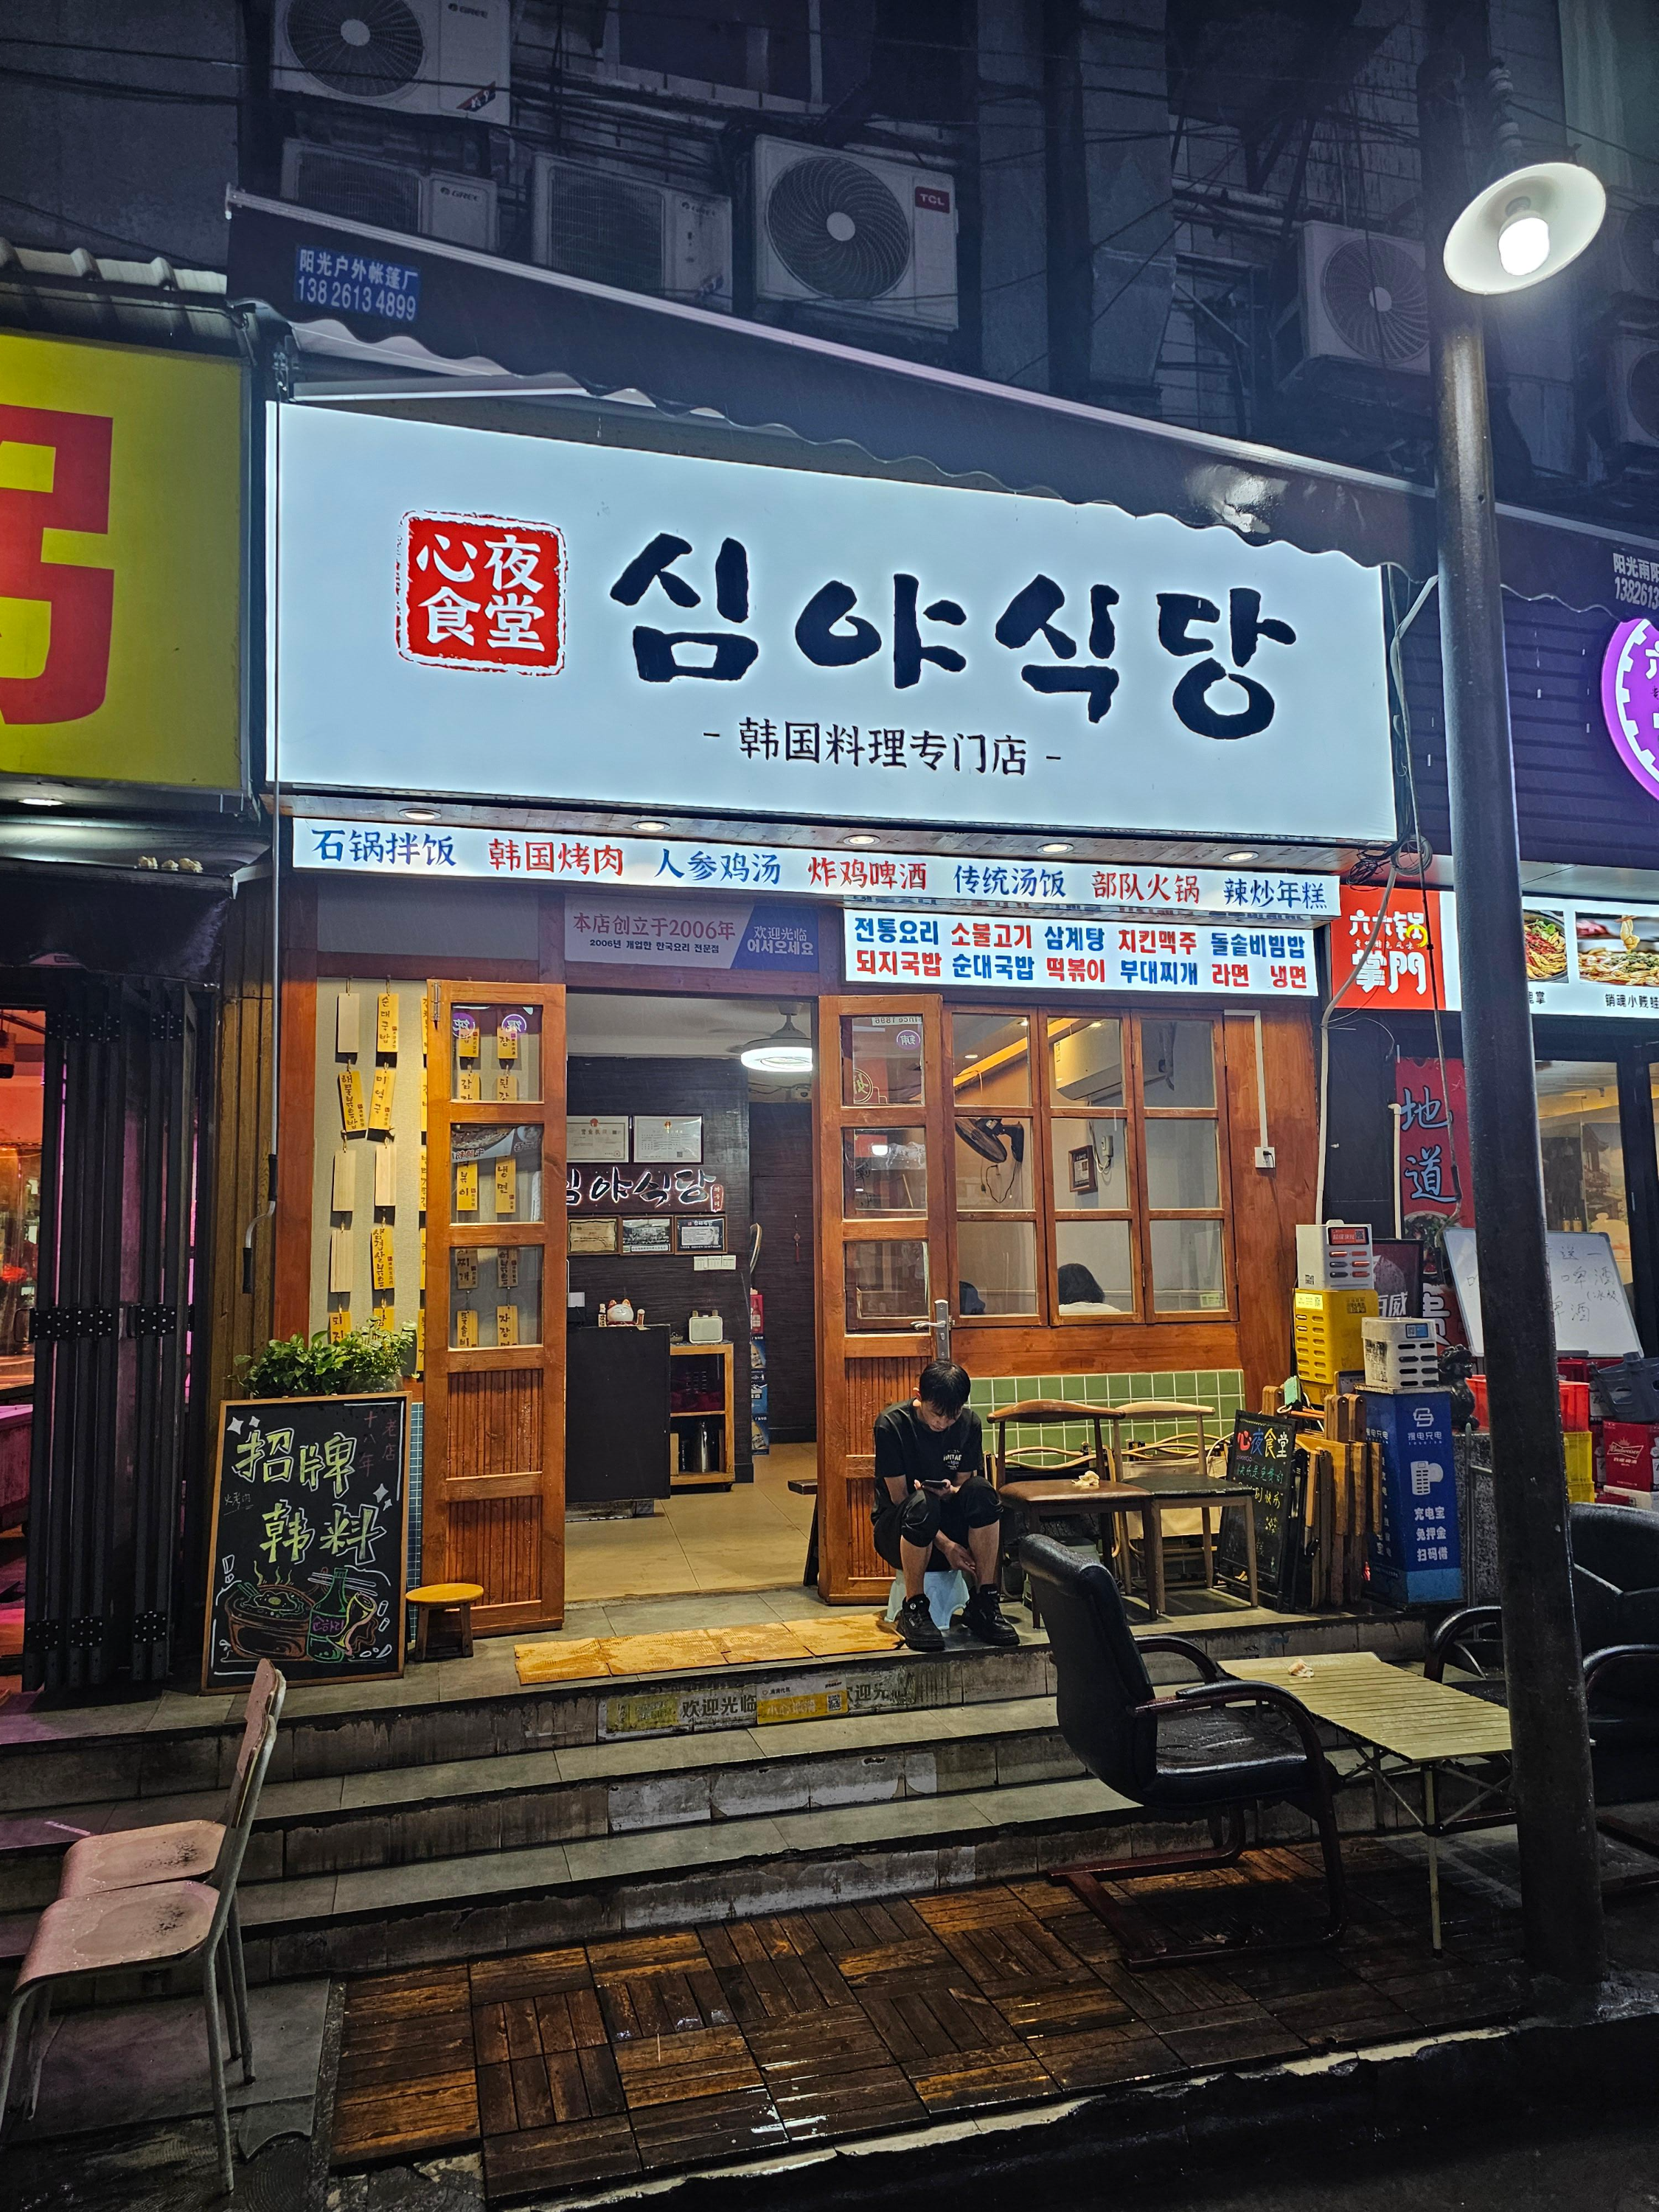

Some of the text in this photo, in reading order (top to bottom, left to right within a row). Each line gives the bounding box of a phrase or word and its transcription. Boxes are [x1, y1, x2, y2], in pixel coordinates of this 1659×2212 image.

[919, 193, 945, 206] TCL
[299, 276, 416, 321] 138 2613 4899
[417, 535, 544, 593] 心夜
[1614, 576, 1659, 611] 1382613
[418, 588, 546, 653] 食堂
[611, 534, 1295, 738] 심야식당
[740, 717, 1027, 776] 韩国料理专门店
[311, 828, 1327, 910] 石锅拌饭 韩国烤肉 人参鸡汤 炸鸡啤酒 传统汤饭 部队火锅 辣炒年糕
[573, 911, 736, 941] 本店创立于2006年
[753, 925, 807, 942] 欢迎光临
[854, 917, 1305, 959] 전통요리 소불고기 삼계탕 치킨맥주 돌솥비빔밥
[590, 939, 720, 953] 2006년 개업한 한국요리 전문점
[746, 938, 814, 956] 어서오세요
[953, 954, 1035, 981] 순대국밥
[1046, 958, 1105, 983] 떡볶이
[1119, 959, 1198, 985] 부대찌개
[1211, 964, 1249, 988] 라면
[1270, 964, 1307, 988] 냉면
[1400, 1087, 1458, 1203] 地道
[497, 1166, 508, 1194] 냉면
[1561, 1266, 1615, 1289] 啤酒
[358, 1411, 378, 1477] 十八年
[1237, 1428, 1289, 1460] 心夜食堂
[1408, 1431, 1442, 1441] 搜电充电
[1610, 1443, 1641, 1456] Budweiser
[232, 1429, 356, 1498] 招牌
[1414, 1506, 1446, 1521] 充电宝
[260, 1500, 387, 1565] 韩料
[1416, 1526, 1447, 1542] 免押金
[1416, 1547, 1449, 1562] 扫码借
[682, 1695, 757, 1718] 欢迎光临
